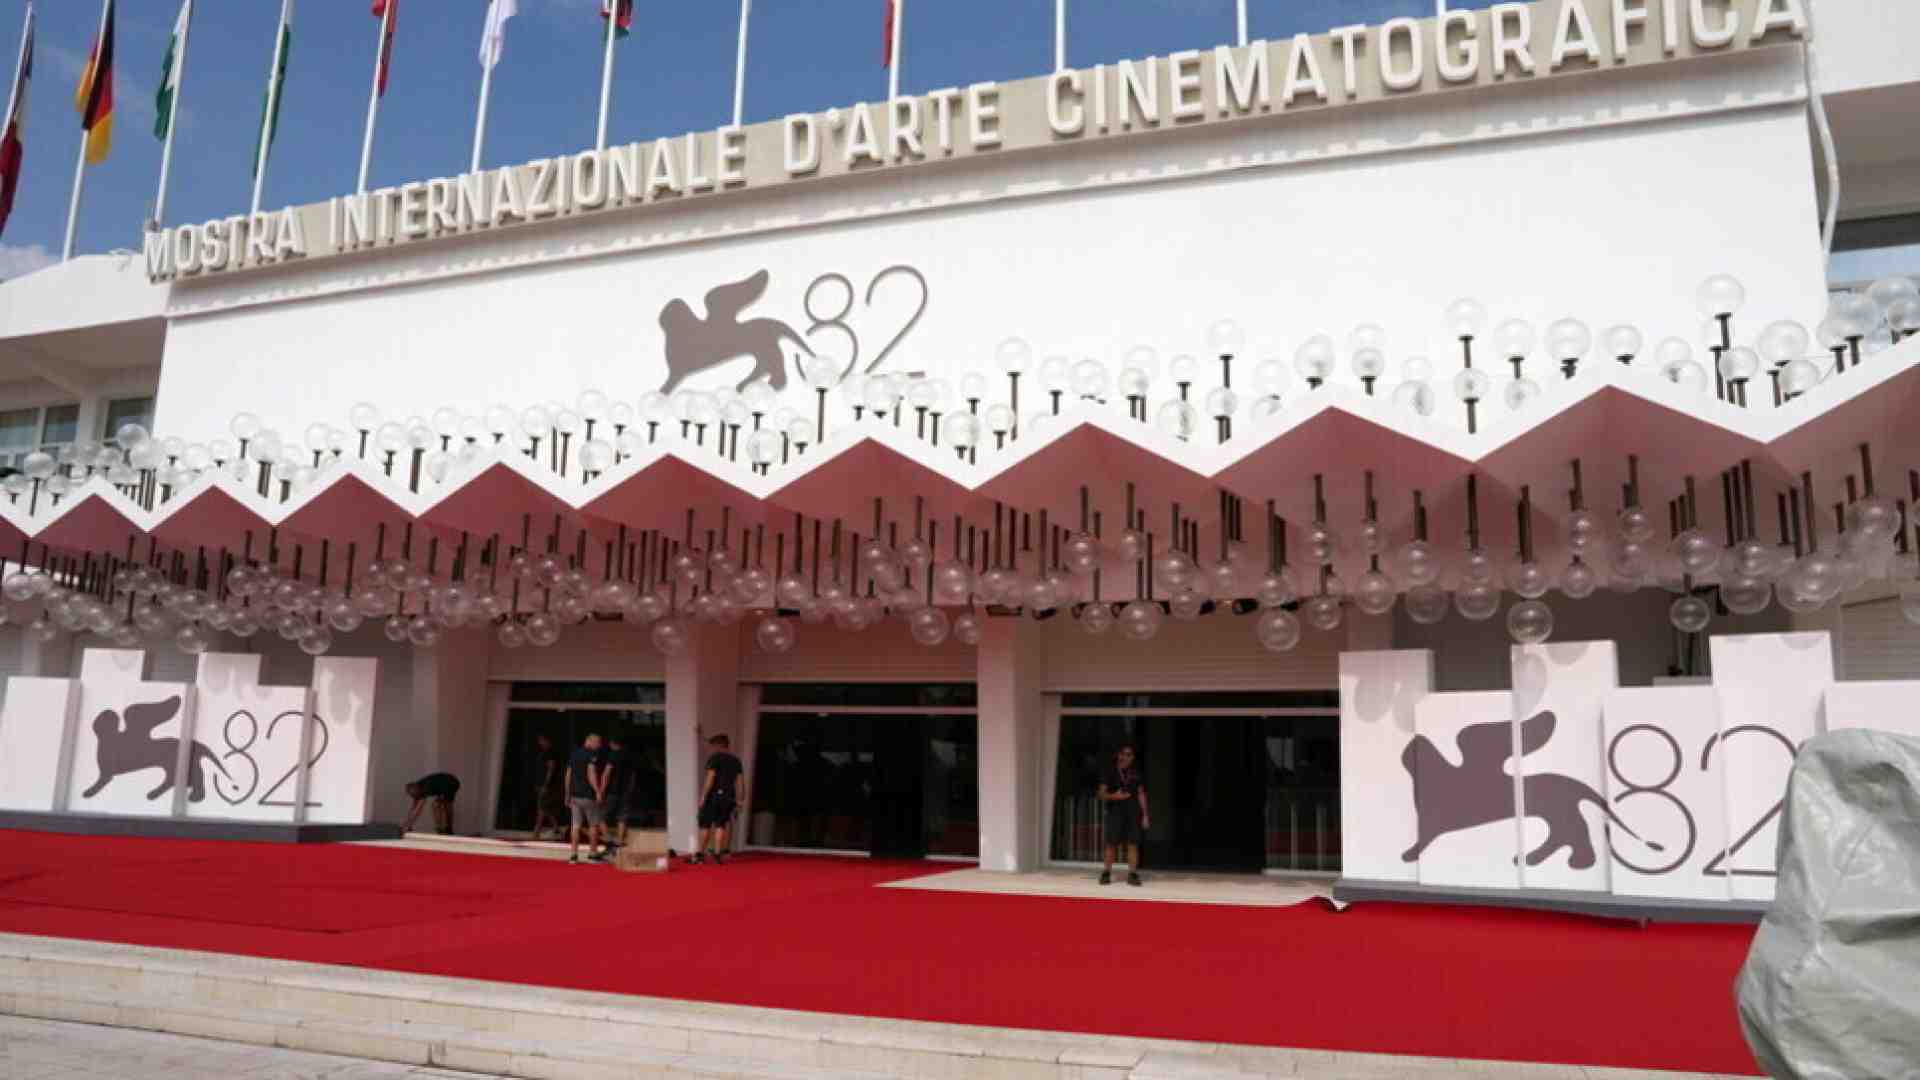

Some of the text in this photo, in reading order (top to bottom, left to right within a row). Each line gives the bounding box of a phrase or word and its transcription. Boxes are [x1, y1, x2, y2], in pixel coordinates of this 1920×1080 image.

[144, 0, 1808, 278] MOSTRA INTERNAZIONALE D'ARTE CINEMATOGRAFICA
[795, 264, 928, 387] 82
[213, 708, 329, 807] 82
[1605, 723, 1800, 876] 82
